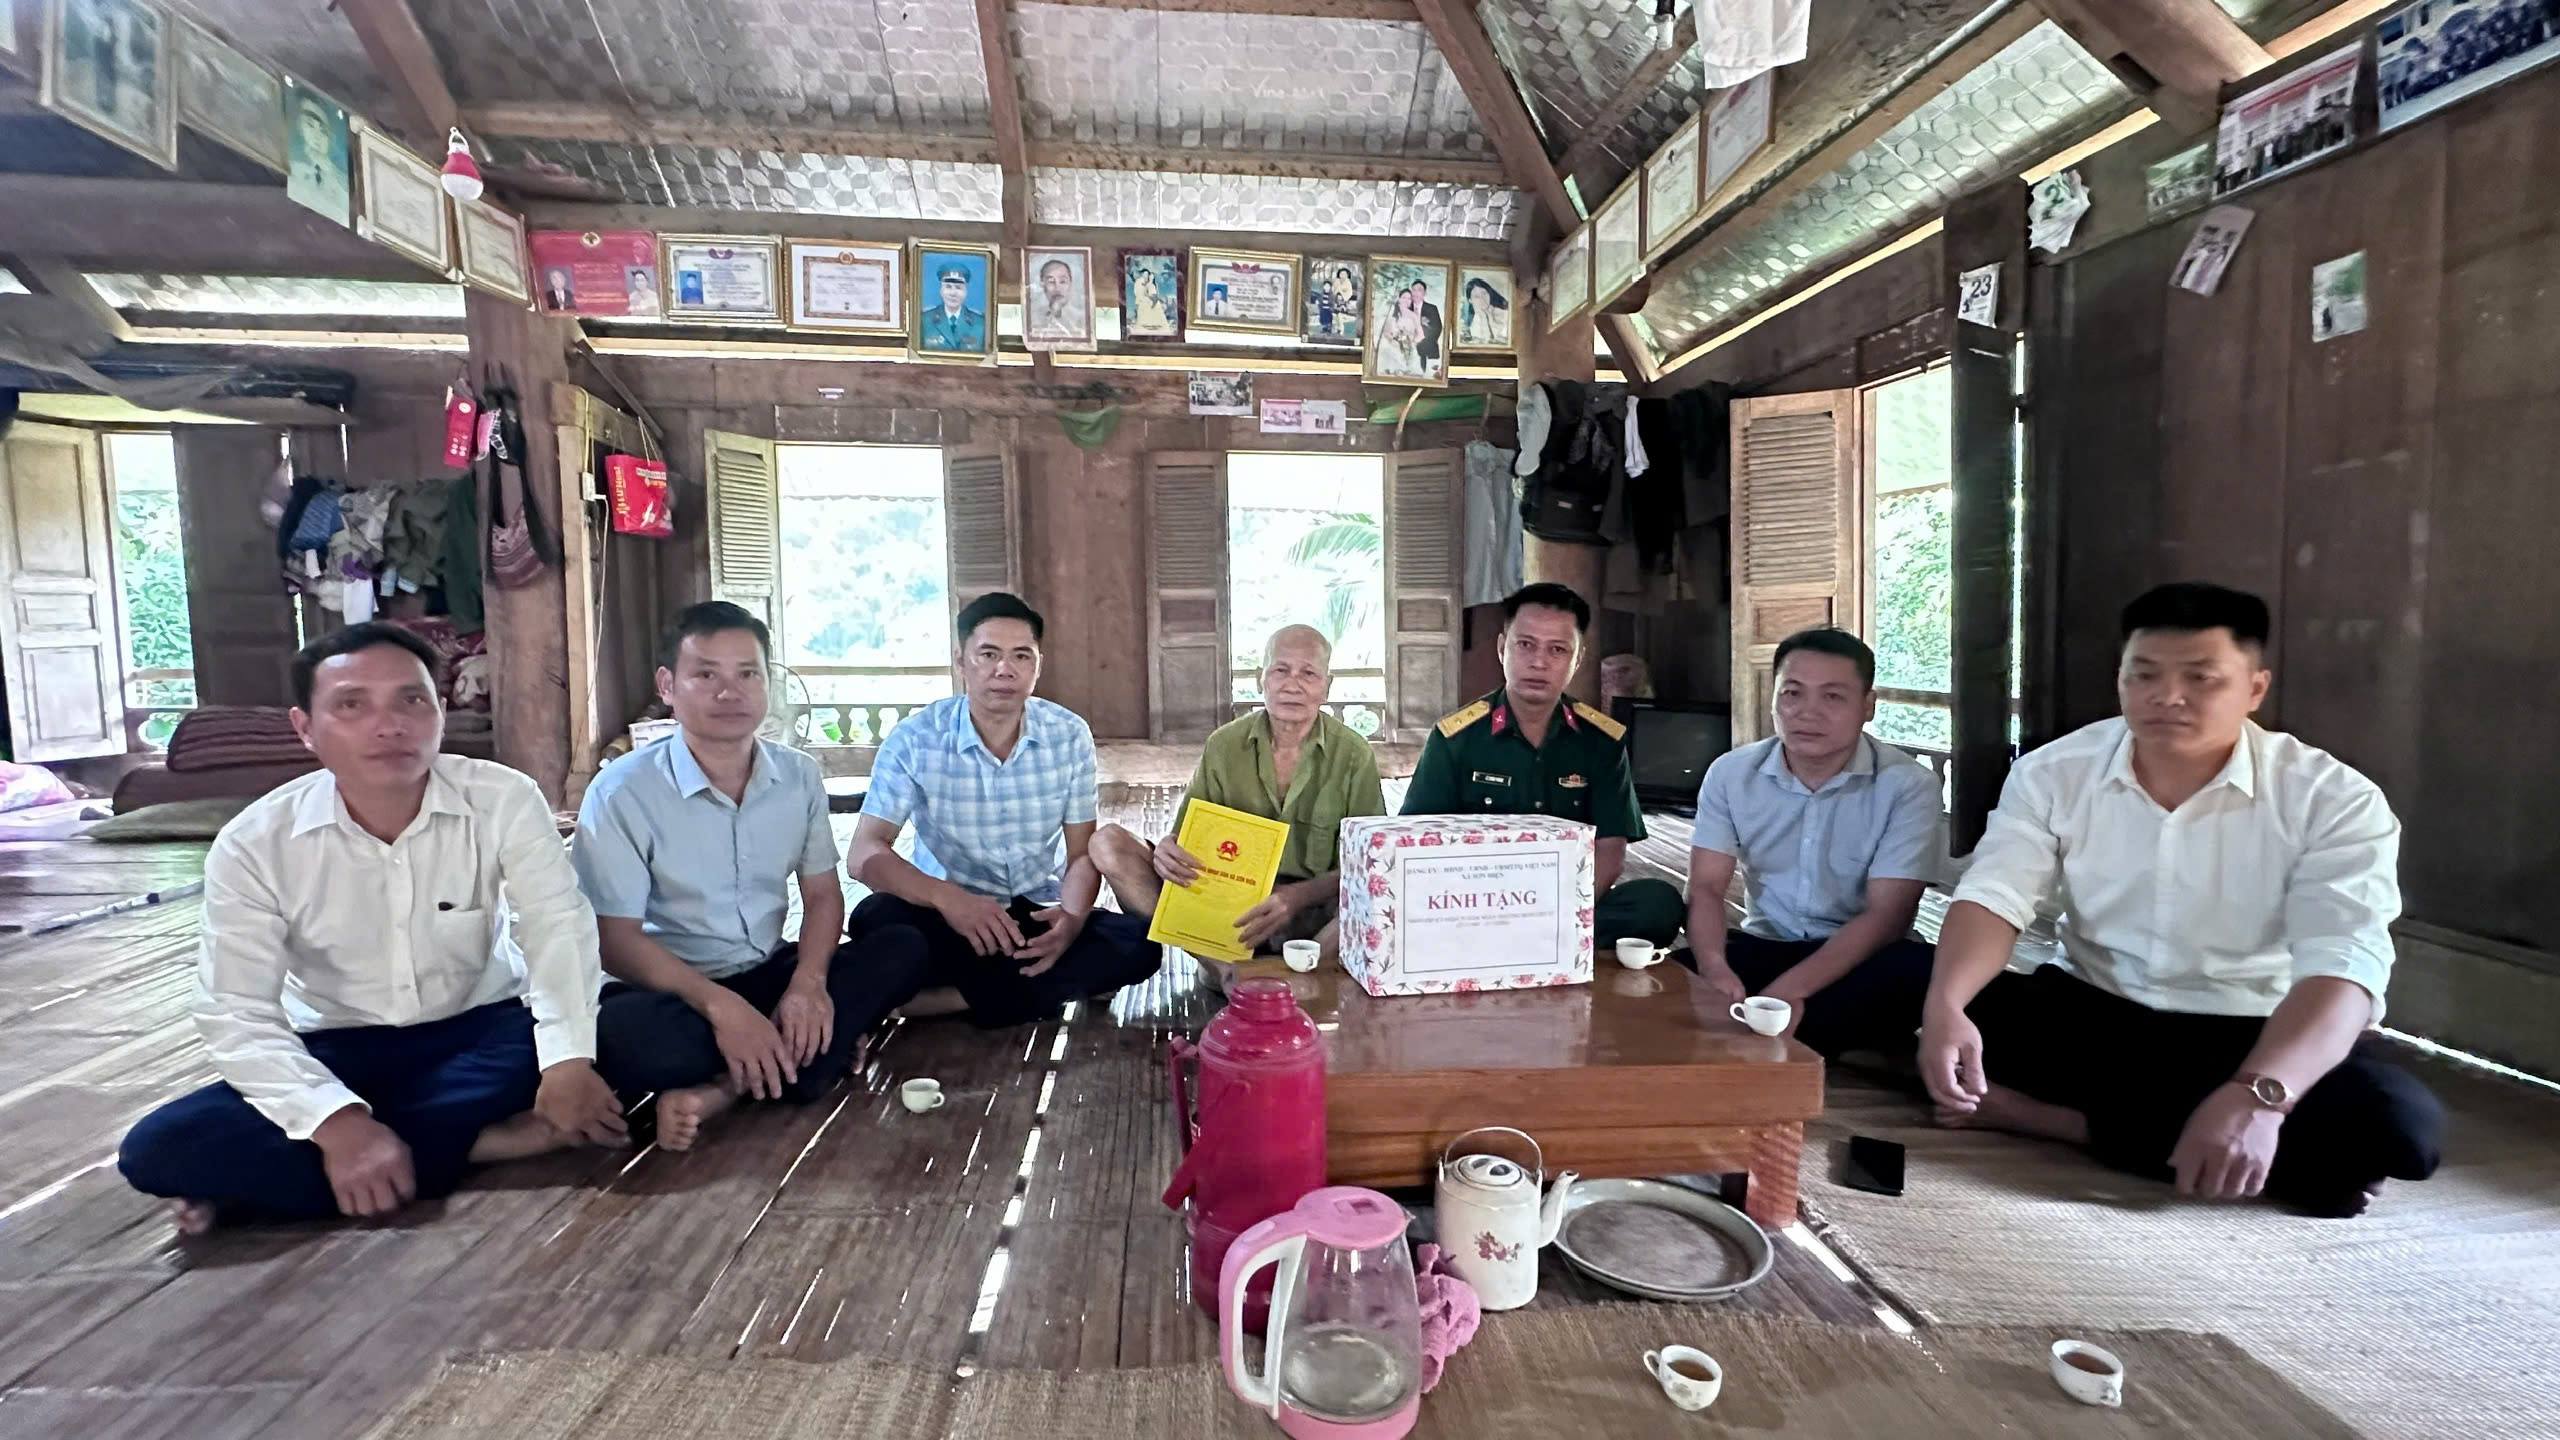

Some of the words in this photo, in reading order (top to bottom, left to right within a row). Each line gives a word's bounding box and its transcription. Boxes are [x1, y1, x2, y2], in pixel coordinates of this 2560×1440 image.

[1970, 273, 1992, 298] 23
[1428, 889, 1477, 910] KÍNH
[1483, 888, 1537, 911] TẶNG
